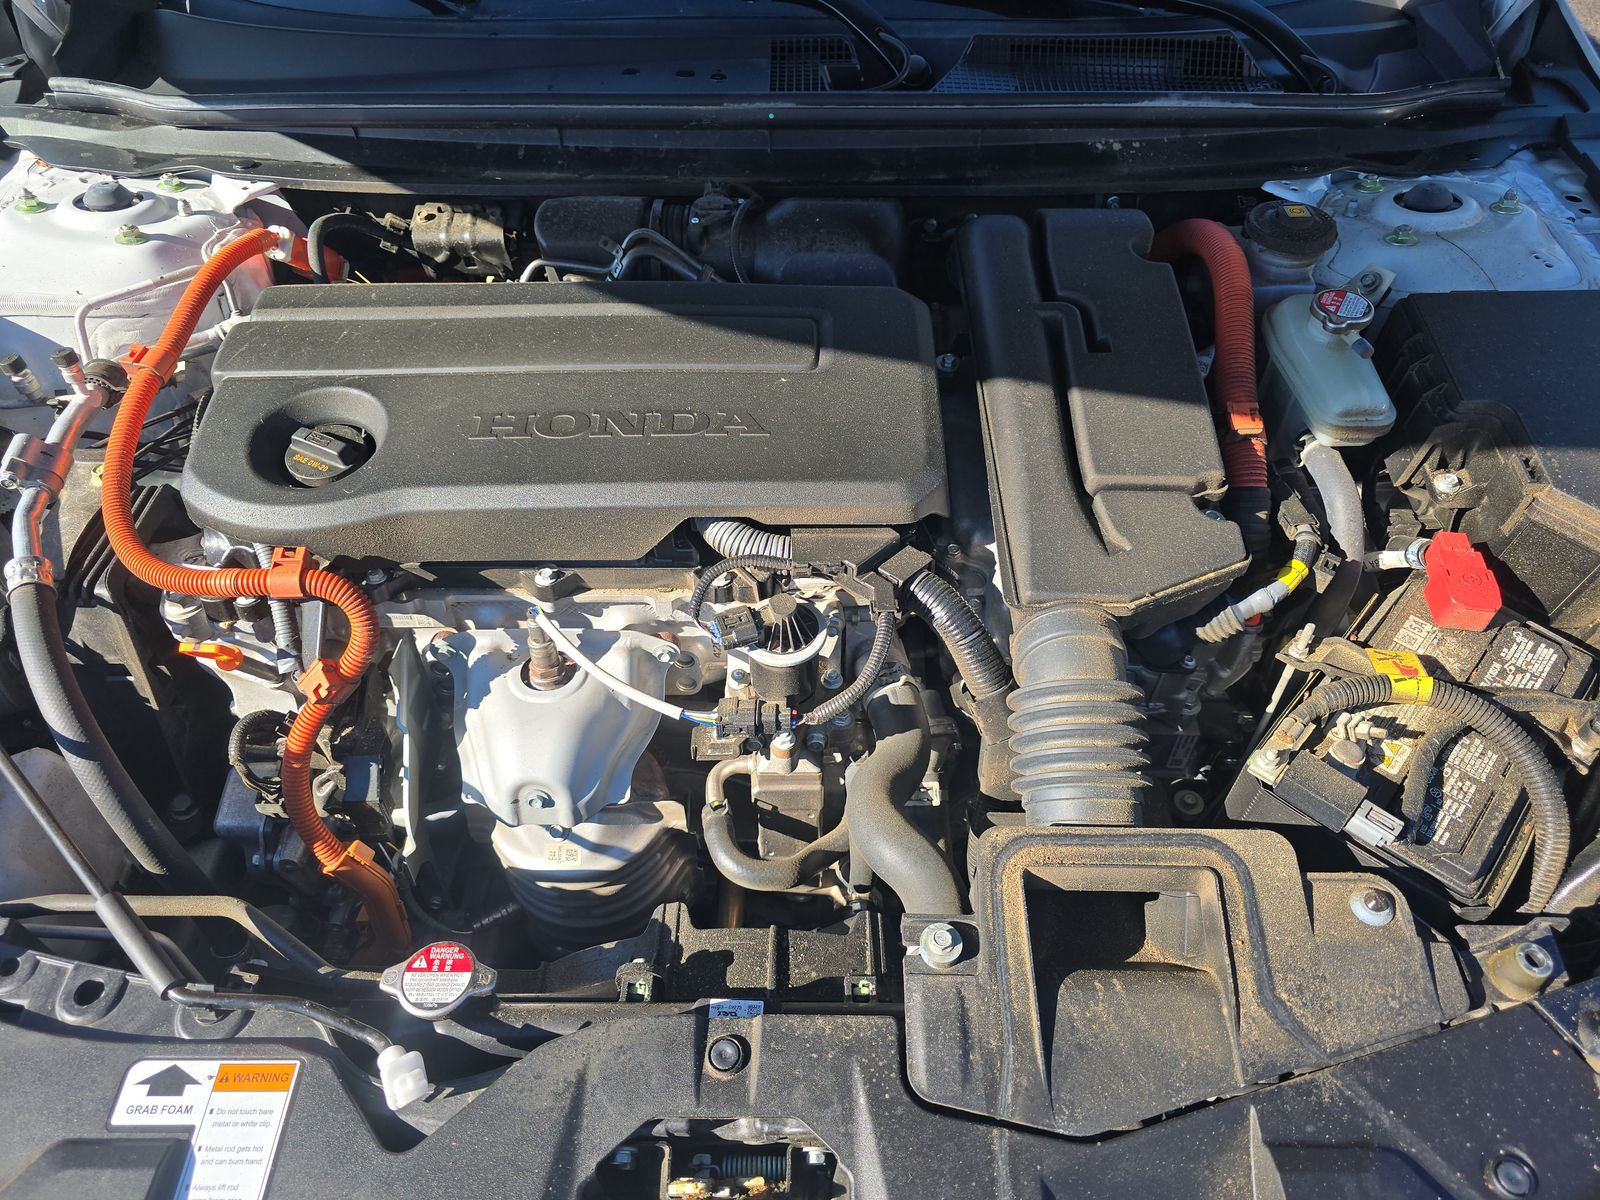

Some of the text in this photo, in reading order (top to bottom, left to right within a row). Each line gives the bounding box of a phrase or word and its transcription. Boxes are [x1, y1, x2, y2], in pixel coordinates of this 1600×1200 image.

[467, 411, 770, 439] HONDA
[293, 454, 329, 472] SAE 0W-20
[233, 1072, 290, 1083] WARNING
[126, 1105, 194, 1115] GRAB FOAM
[259, 1120, 272, 1128] clip.
[237, 1146, 251, 1154] gets
[192, 1183, 240, 1193] Always lift rod
